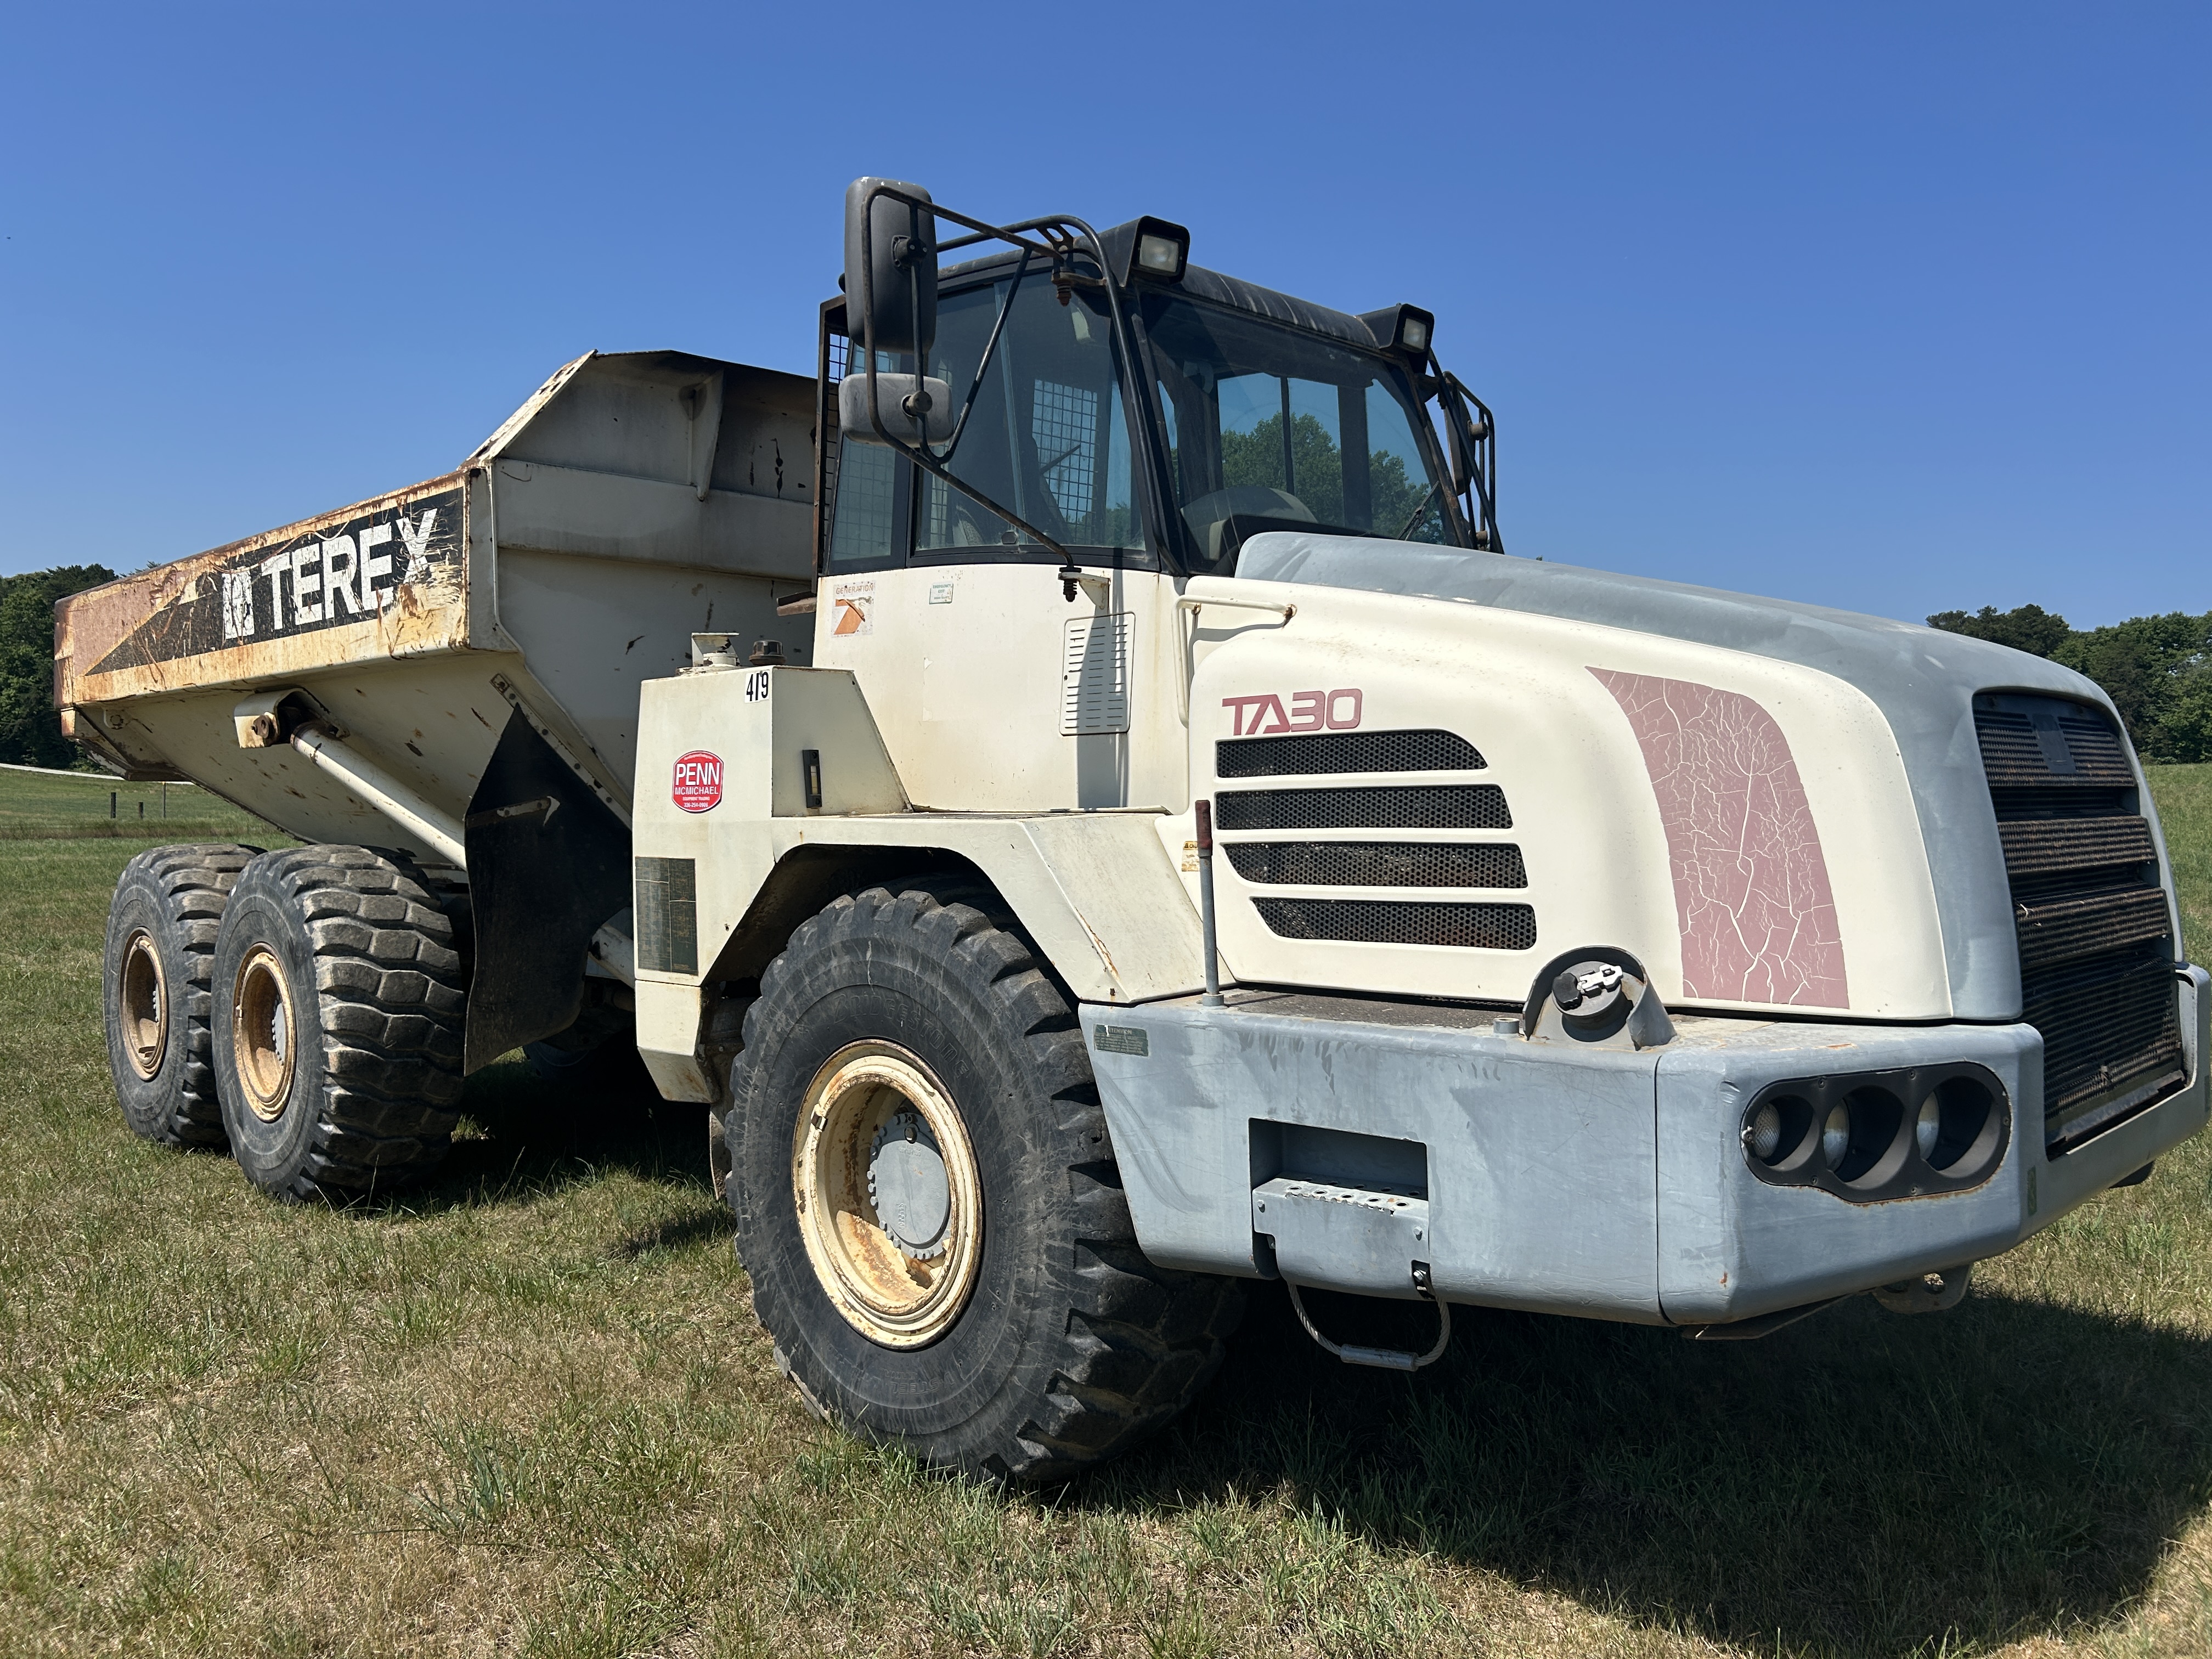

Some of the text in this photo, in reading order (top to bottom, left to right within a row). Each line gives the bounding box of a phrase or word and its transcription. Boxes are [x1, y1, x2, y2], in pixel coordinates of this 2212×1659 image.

[261, 508, 438, 630] TEREX
[836, 584, 873, 594] GENERATION
[746, 672, 769, 702] 419
[1222, 689, 1363, 736] TA30
[675, 761, 720, 786] PENN
[675, 786, 719, 795] MCMICHAEL
